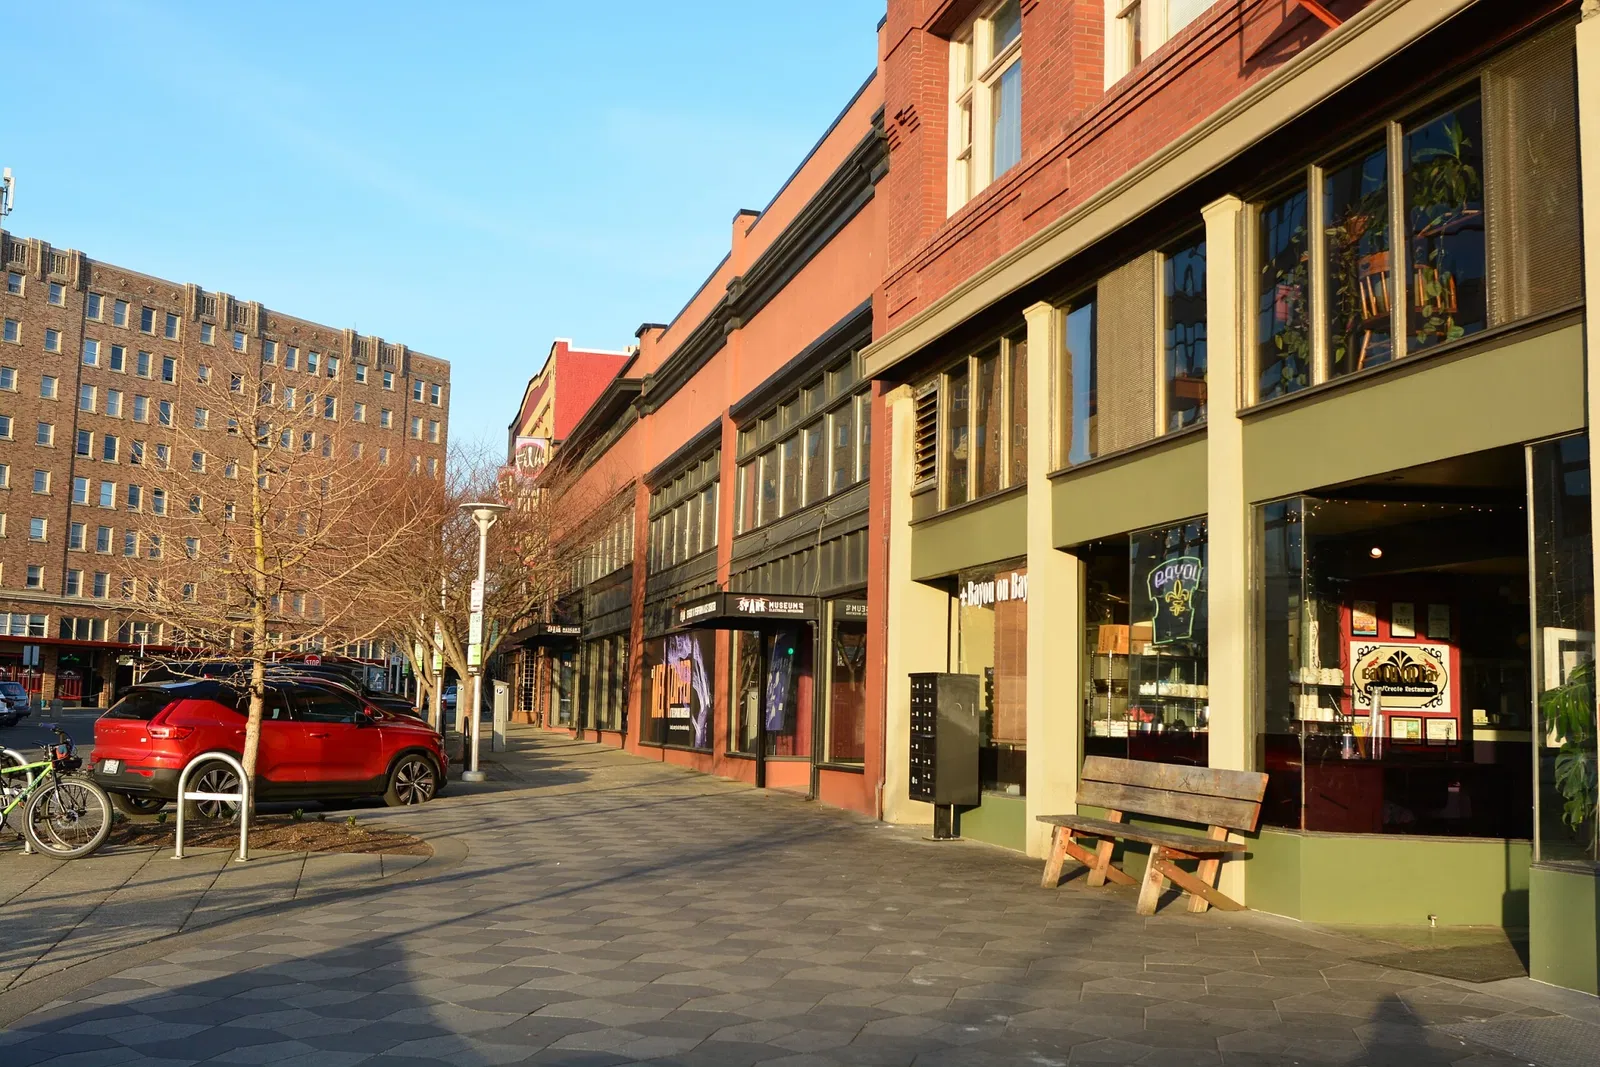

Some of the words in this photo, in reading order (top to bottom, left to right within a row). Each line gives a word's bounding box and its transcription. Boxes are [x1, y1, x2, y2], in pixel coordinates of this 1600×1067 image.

[967, 581, 995, 609] Bayou
[996, 578, 1009, 602] on
[1010, 572, 1028, 603] Bay
[737, 597, 767, 614] SPARK
[768, 601, 798, 610] MUSEUM
[1362, 666, 1398, 683] Bayou
[1418, 664, 1441, 683] Bay
[1404, 686, 1436, 694] Restaurant
